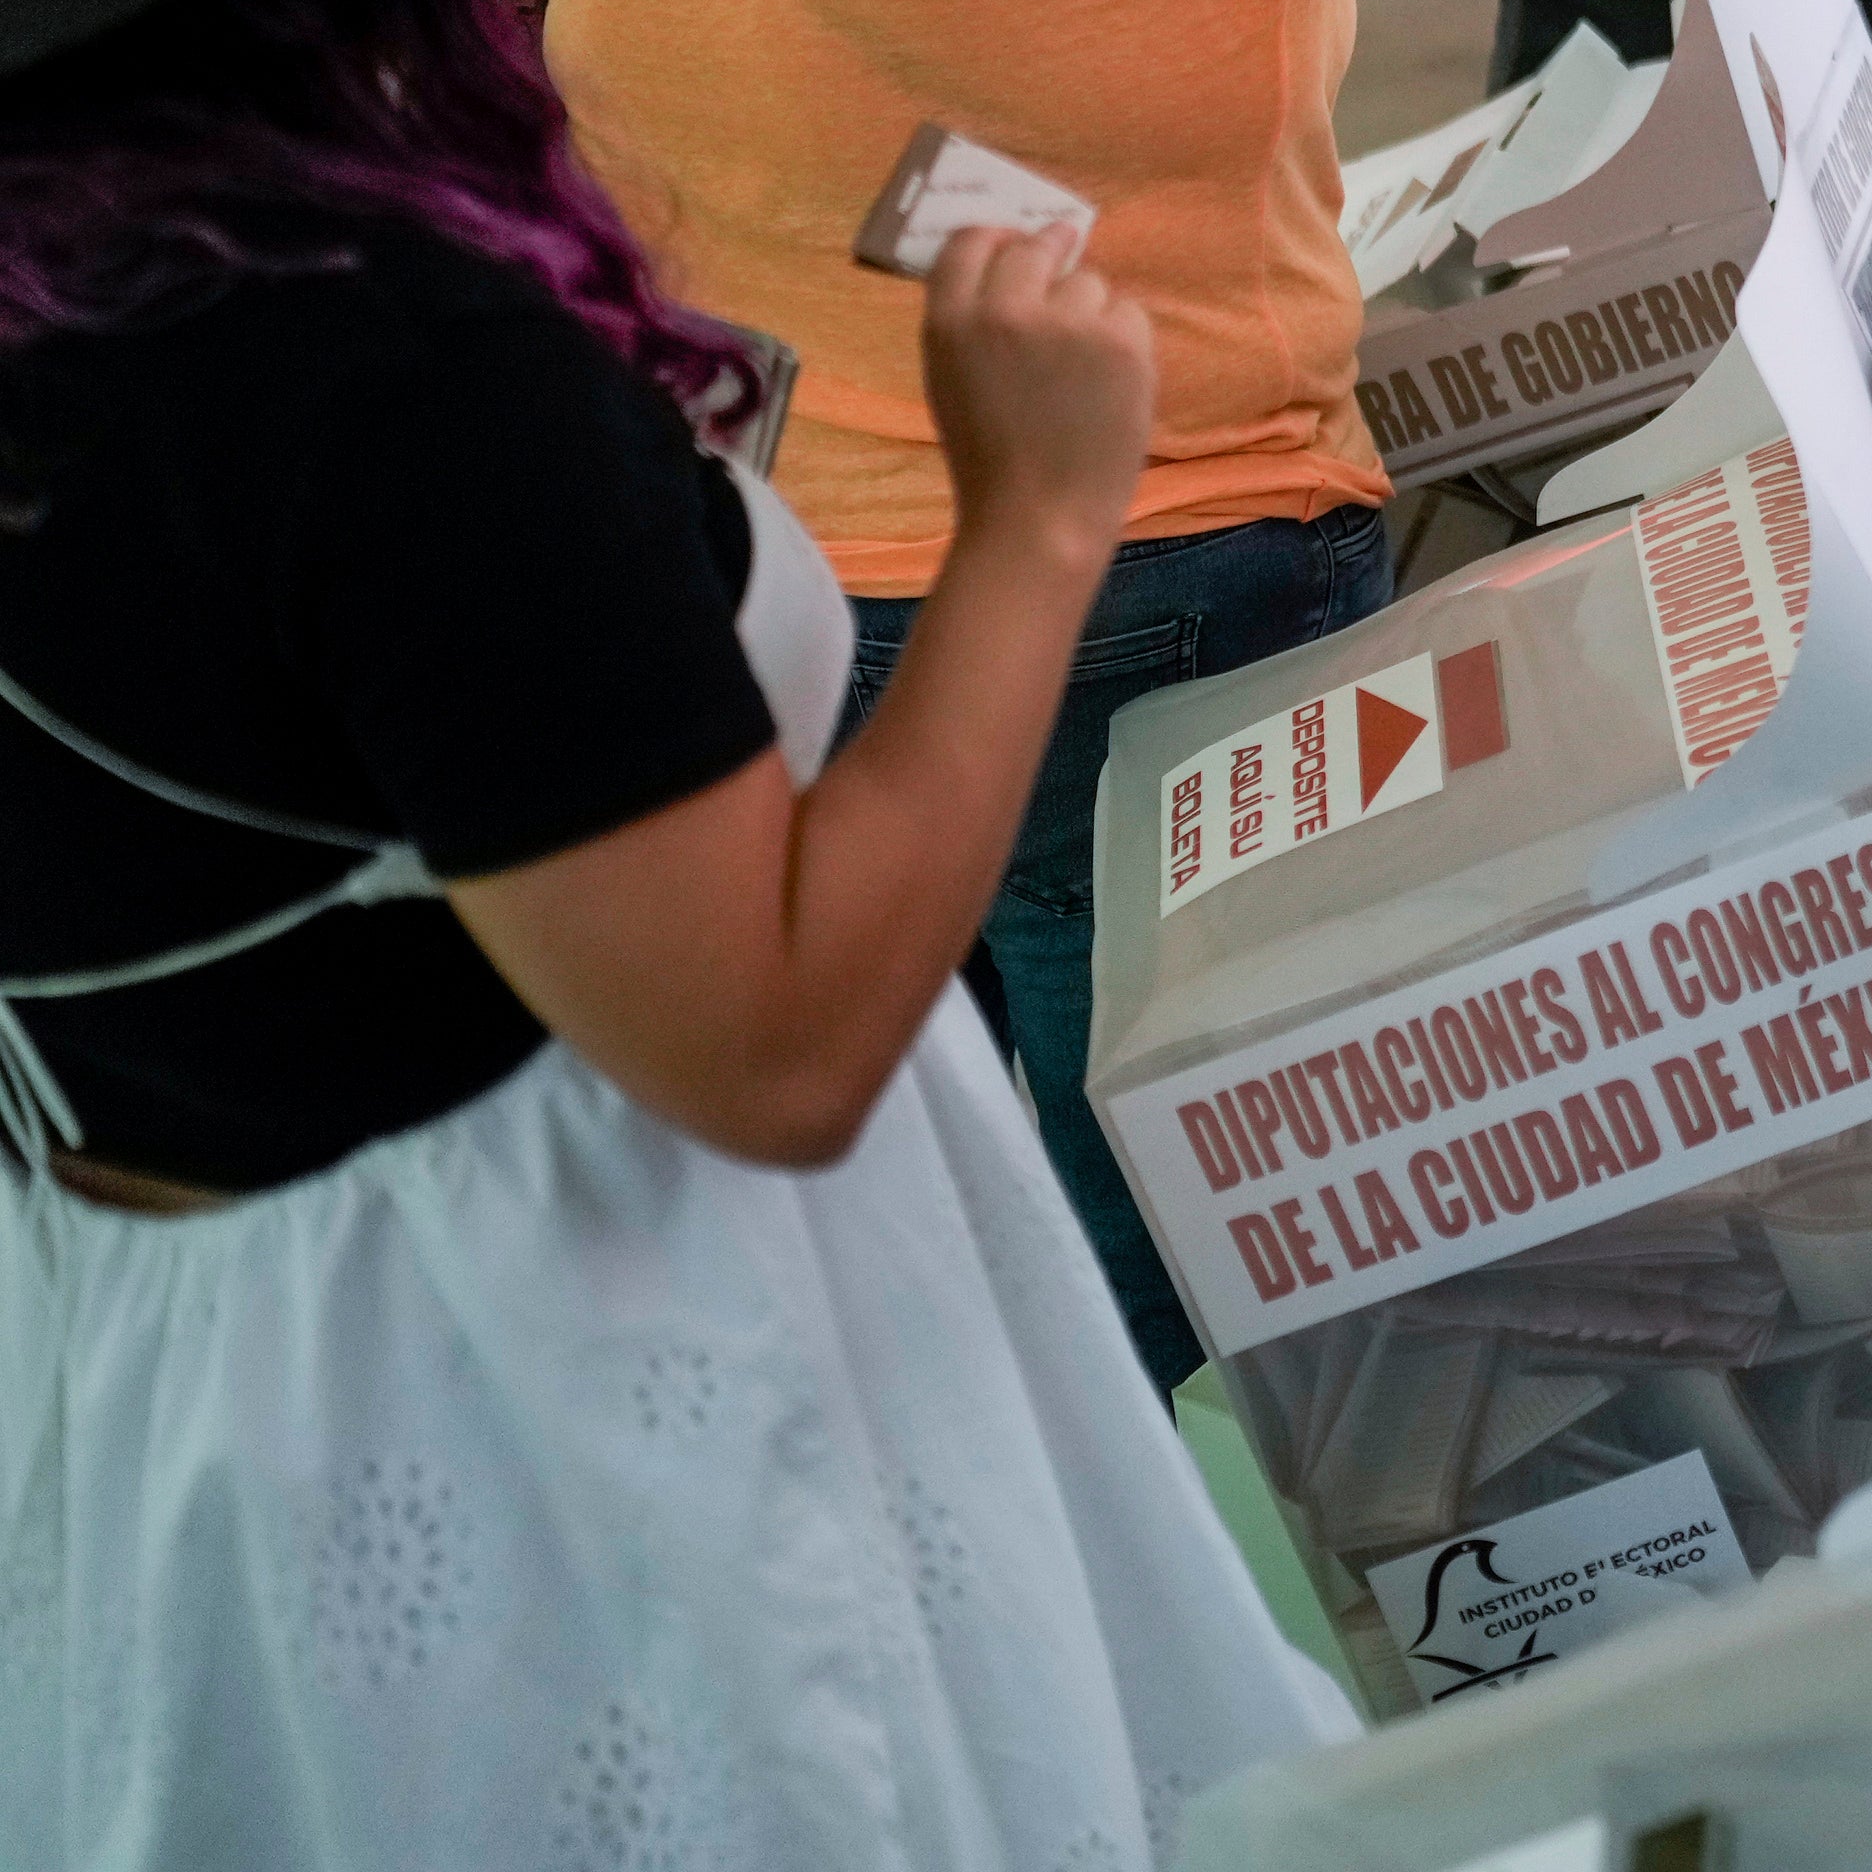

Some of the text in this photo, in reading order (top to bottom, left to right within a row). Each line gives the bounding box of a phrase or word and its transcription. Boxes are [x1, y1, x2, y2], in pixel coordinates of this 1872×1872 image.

[1427, 343, 1508, 426] DE
[1640, 488, 1730, 544] LA
[1644, 521, 1754, 636] CIUDAD
[1666, 614, 1764, 676] DE
[1292, 700, 1327, 842] DEPOSITE
[1674, 651, 1790, 785] MÉXIC
[1171, 771, 1201, 895] BOLETA
[1230, 744, 1275, 859] AQUÍ SU
[1176, 966, 1589, 1194] DIPUTACIONES
[1575, 940, 1662, 1049] AL
[1226, 1194, 1332, 1304] DE
[1319, 1169, 1421, 1273] LA
[1406, 1076, 1662, 1240] CIUDAD
[1655, 1039, 1755, 1152] DE
[1458, 1571, 1578, 1625] INSTITUTO
[1484, 1598, 1573, 1639] CIUDAD
